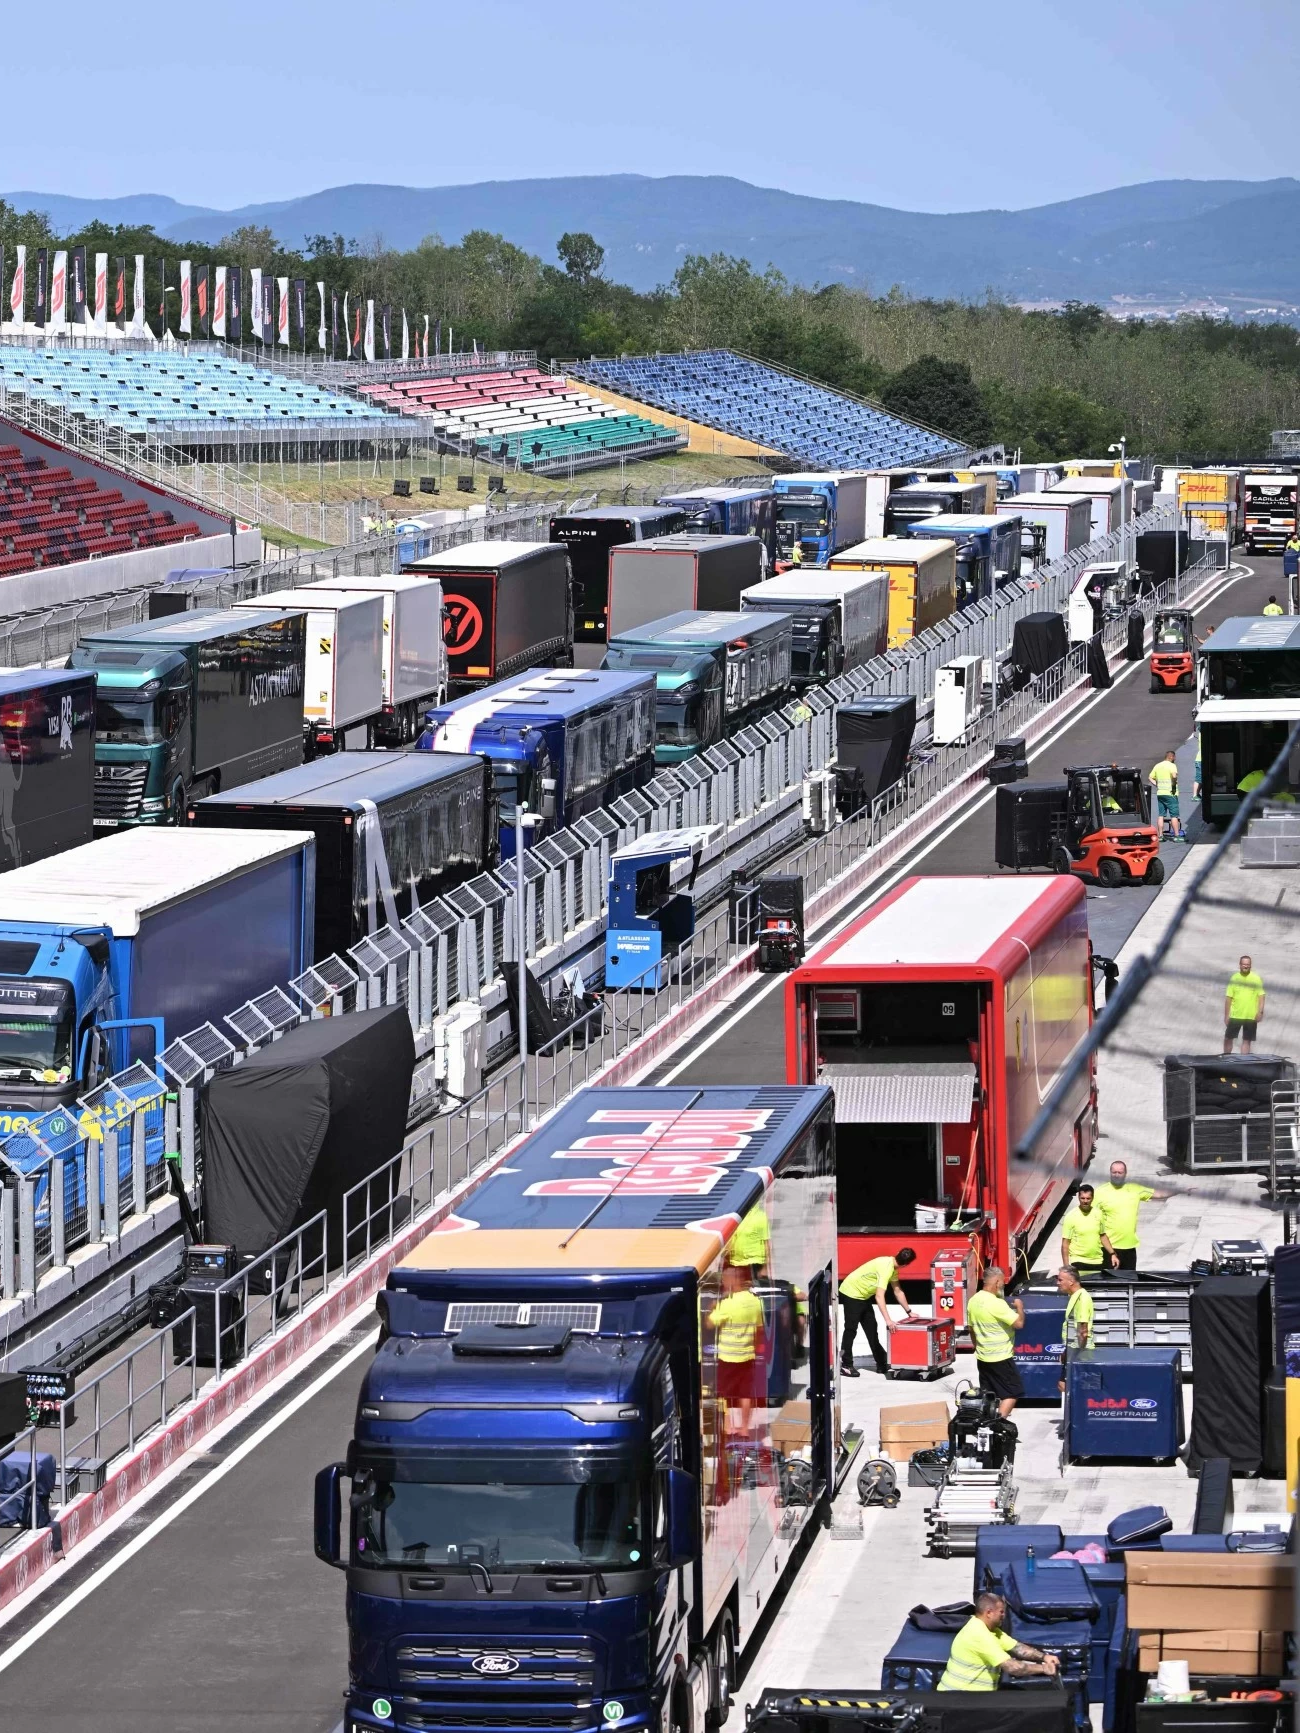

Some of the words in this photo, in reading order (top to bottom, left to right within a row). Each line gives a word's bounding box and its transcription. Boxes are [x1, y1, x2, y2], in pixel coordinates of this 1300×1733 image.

[248, 672, 273, 708] ASTON
[47, 715, 60, 736] VISA
[457, 785, 482, 808] ALPINE
[616, 943, 650, 951] Williams
[943, 1005, 954, 1014] 09
[568, 1109, 776, 1150] Bull
[522, 1149, 743, 1196] Red
[940, 1296, 954, 1308] 09
[1013, 1343, 1024, 1353] ed
[1024, 1343, 1043, 1353] Bull
[1087, 1398, 1108, 1408] Red
[1108, 1398, 1128, 1408] Bull
[1087, 1410, 1158, 1418] POWERTRAINS
[480, 1657, 511, 1671] Ford
[377, 1702, 387, 1715] L
[607, 1705, 620, 1717] VI
